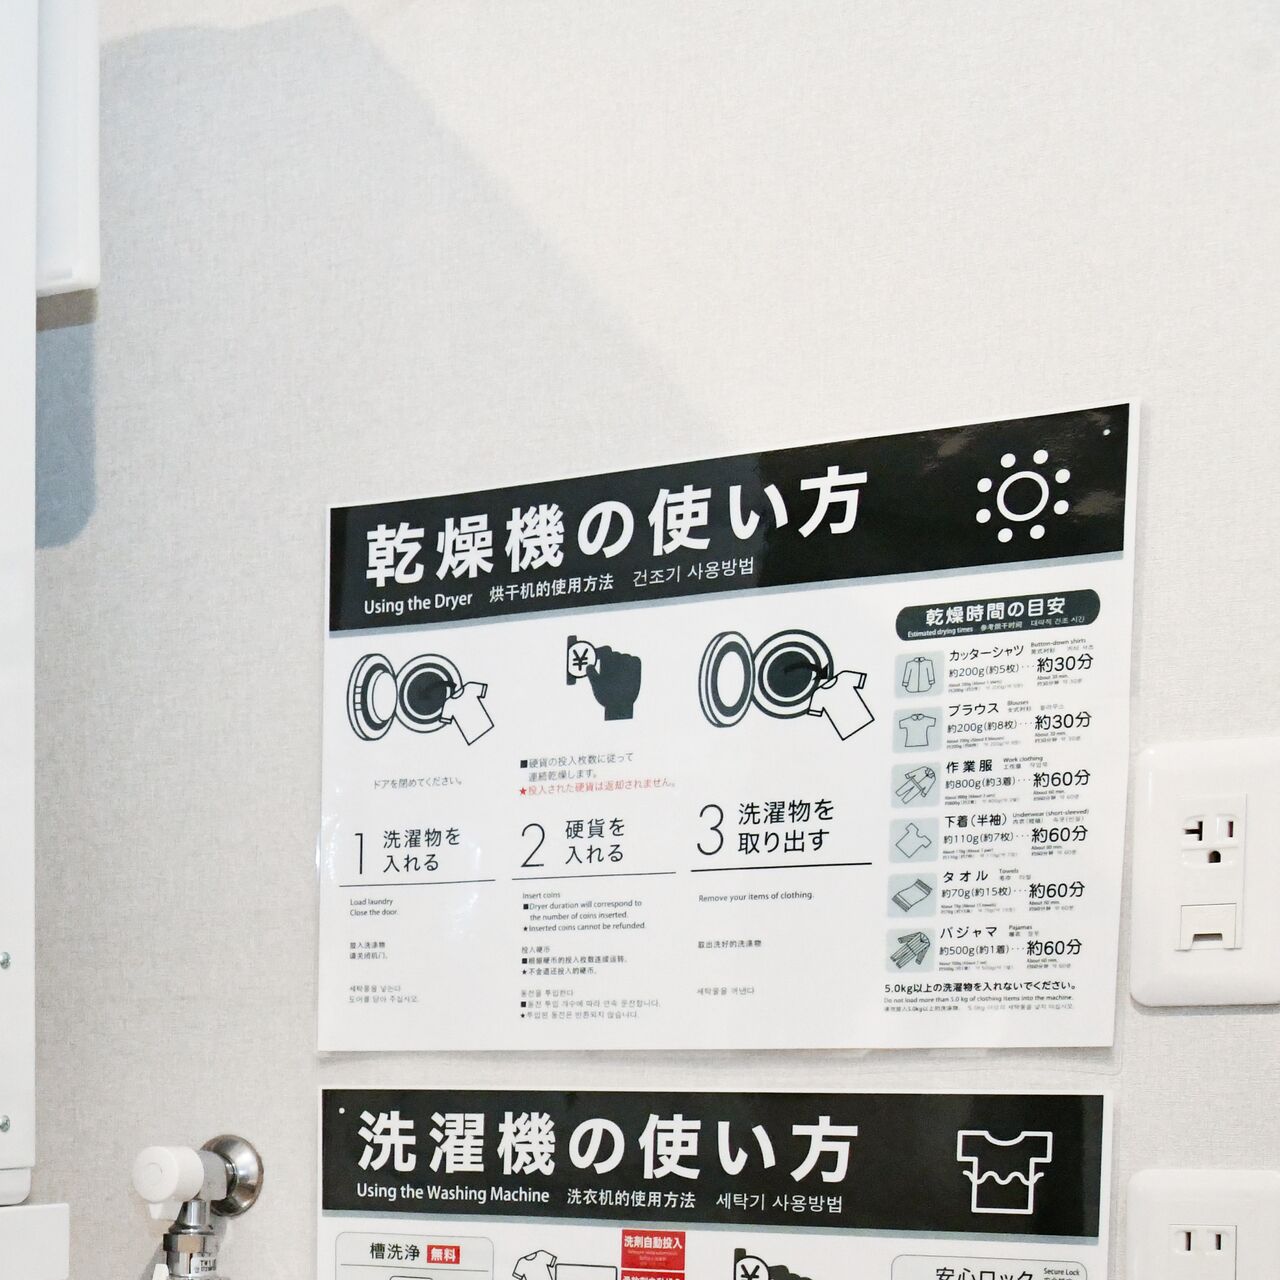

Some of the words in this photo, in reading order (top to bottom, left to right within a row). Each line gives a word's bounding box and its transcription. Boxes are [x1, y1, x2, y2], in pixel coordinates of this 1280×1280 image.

[365, 466, 869, 588] 乾燥機の使い方
[633, 565, 680, 588] 건조기
[687, 557, 754, 581] 사용방법
[489, 574, 613, 603] 烘干机的使用方法
[364, 596, 404, 616] Using
[408, 594, 431, 612] the
[434, 591, 472, 612] Dryer
[926, 597, 1065, 626] 乾燥時間の目安
[950, 645, 1024, 662] カッターシャツ
[948, 702, 999, 717] ブラウス
[528, 752, 634, 769] 硬貨の投入枚数に従って
[946, 759, 993, 774] 作業服
[373, 777, 463, 790] ドアを閉めてください。
[697, 804, 723, 855] 3
[738, 799, 834, 825] 洗濯物を
[354, 832, 363, 874] 1
[383, 827, 461, 849] 洗濯物を
[521, 823, 545, 867] 2
[565, 817, 625, 839] 硬貨を
[738, 829, 829, 855] 取り出す
[383, 854, 439, 873] 入れる
[565, 844, 624, 865] 入れる
[943, 871, 988, 884] タオル
[699, 895, 728, 903] Remove
[730, 894, 746, 904] your
[748, 892, 769, 901] items
[771, 892, 778, 900] of
[780, 890, 814, 901] clothing.
[1029, 882, 1085, 900] 約60分
[350, 898, 366, 906] Load
[368, 897, 393, 908] laundry
[1027, 939, 1082, 957] 約60分
[885, 980, 1076, 995] 5.0kg以上の洗濯物を入れないでください。
[357, 1110, 858, 1183] 洗濯機の使い方
[357, 1182, 396, 1200] Using
[400, 1184, 423, 1199] the
[426, 1185, 487, 1204] Washing
[489, 1186, 550, 1203] Machine
[567, 1188, 696, 1211] 洗衣机的使用方法
[716, 1192, 765, 1211] 세탁기
[772, 1194, 843, 1214] 사용방법
[370, 1242, 420, 1261] 槽洗浄
[430, 1248, 456, 1262] 無料
[623, 1234, 683, 1251] 洗剤自動投入
